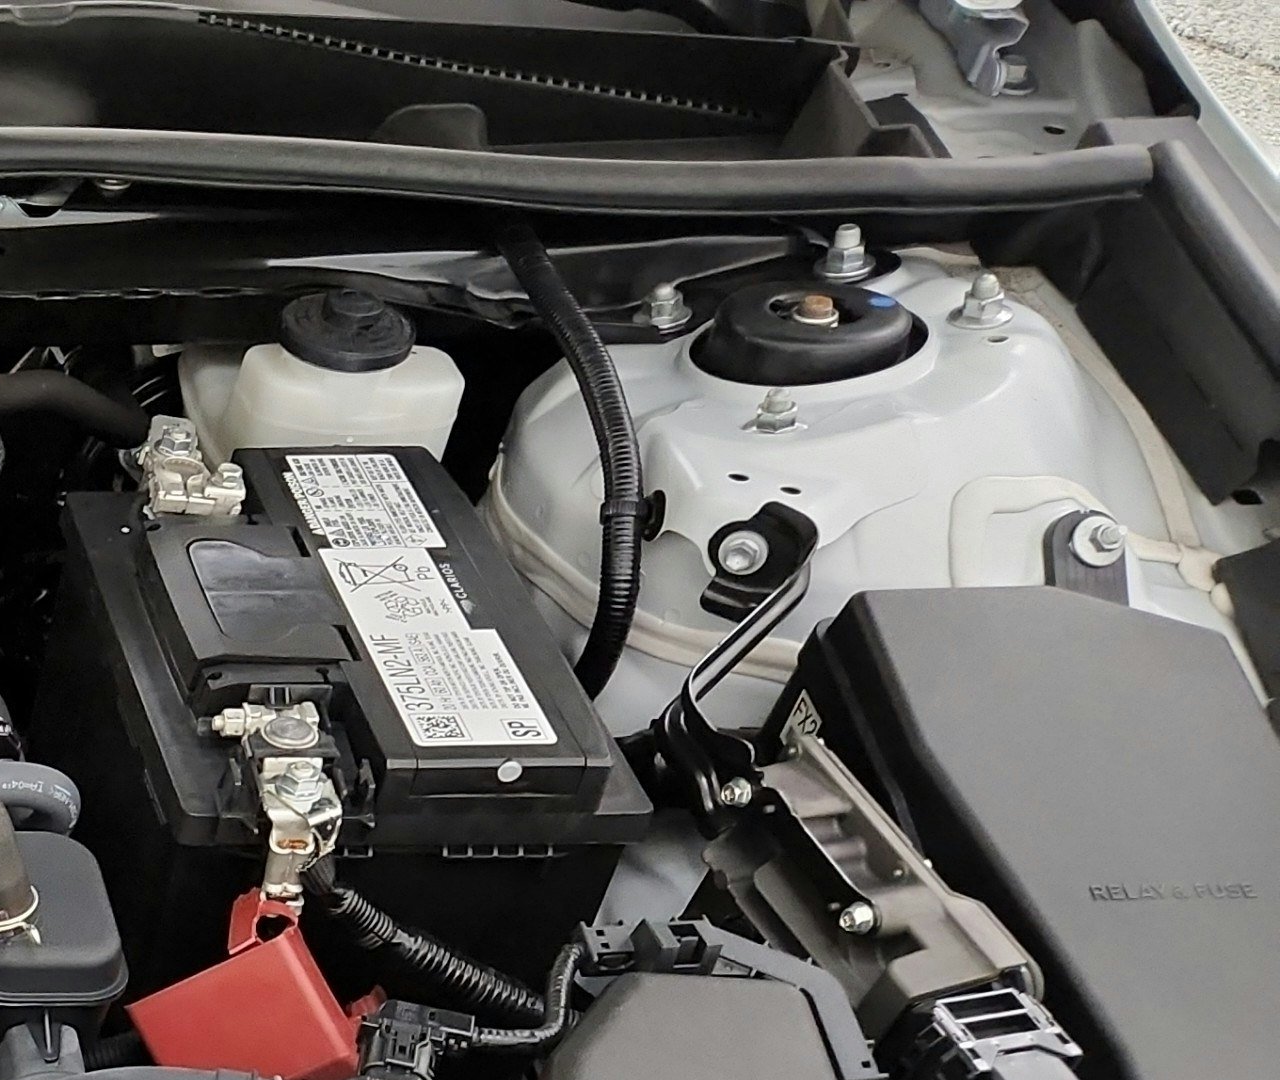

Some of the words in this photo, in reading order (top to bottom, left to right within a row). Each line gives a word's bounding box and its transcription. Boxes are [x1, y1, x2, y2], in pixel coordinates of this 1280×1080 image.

[416, 565, 435, 581] Pb
[439, 563, 468, 600] CLARIOS
[369, 633, 435, 711] 375LN2-MF
[507, 721, 542, 737] SP
[1088, 882, 1165, 902] RELAY
[1172, 884, 1190, 900] &
[1193, 882, 1259, 900] FUSE
